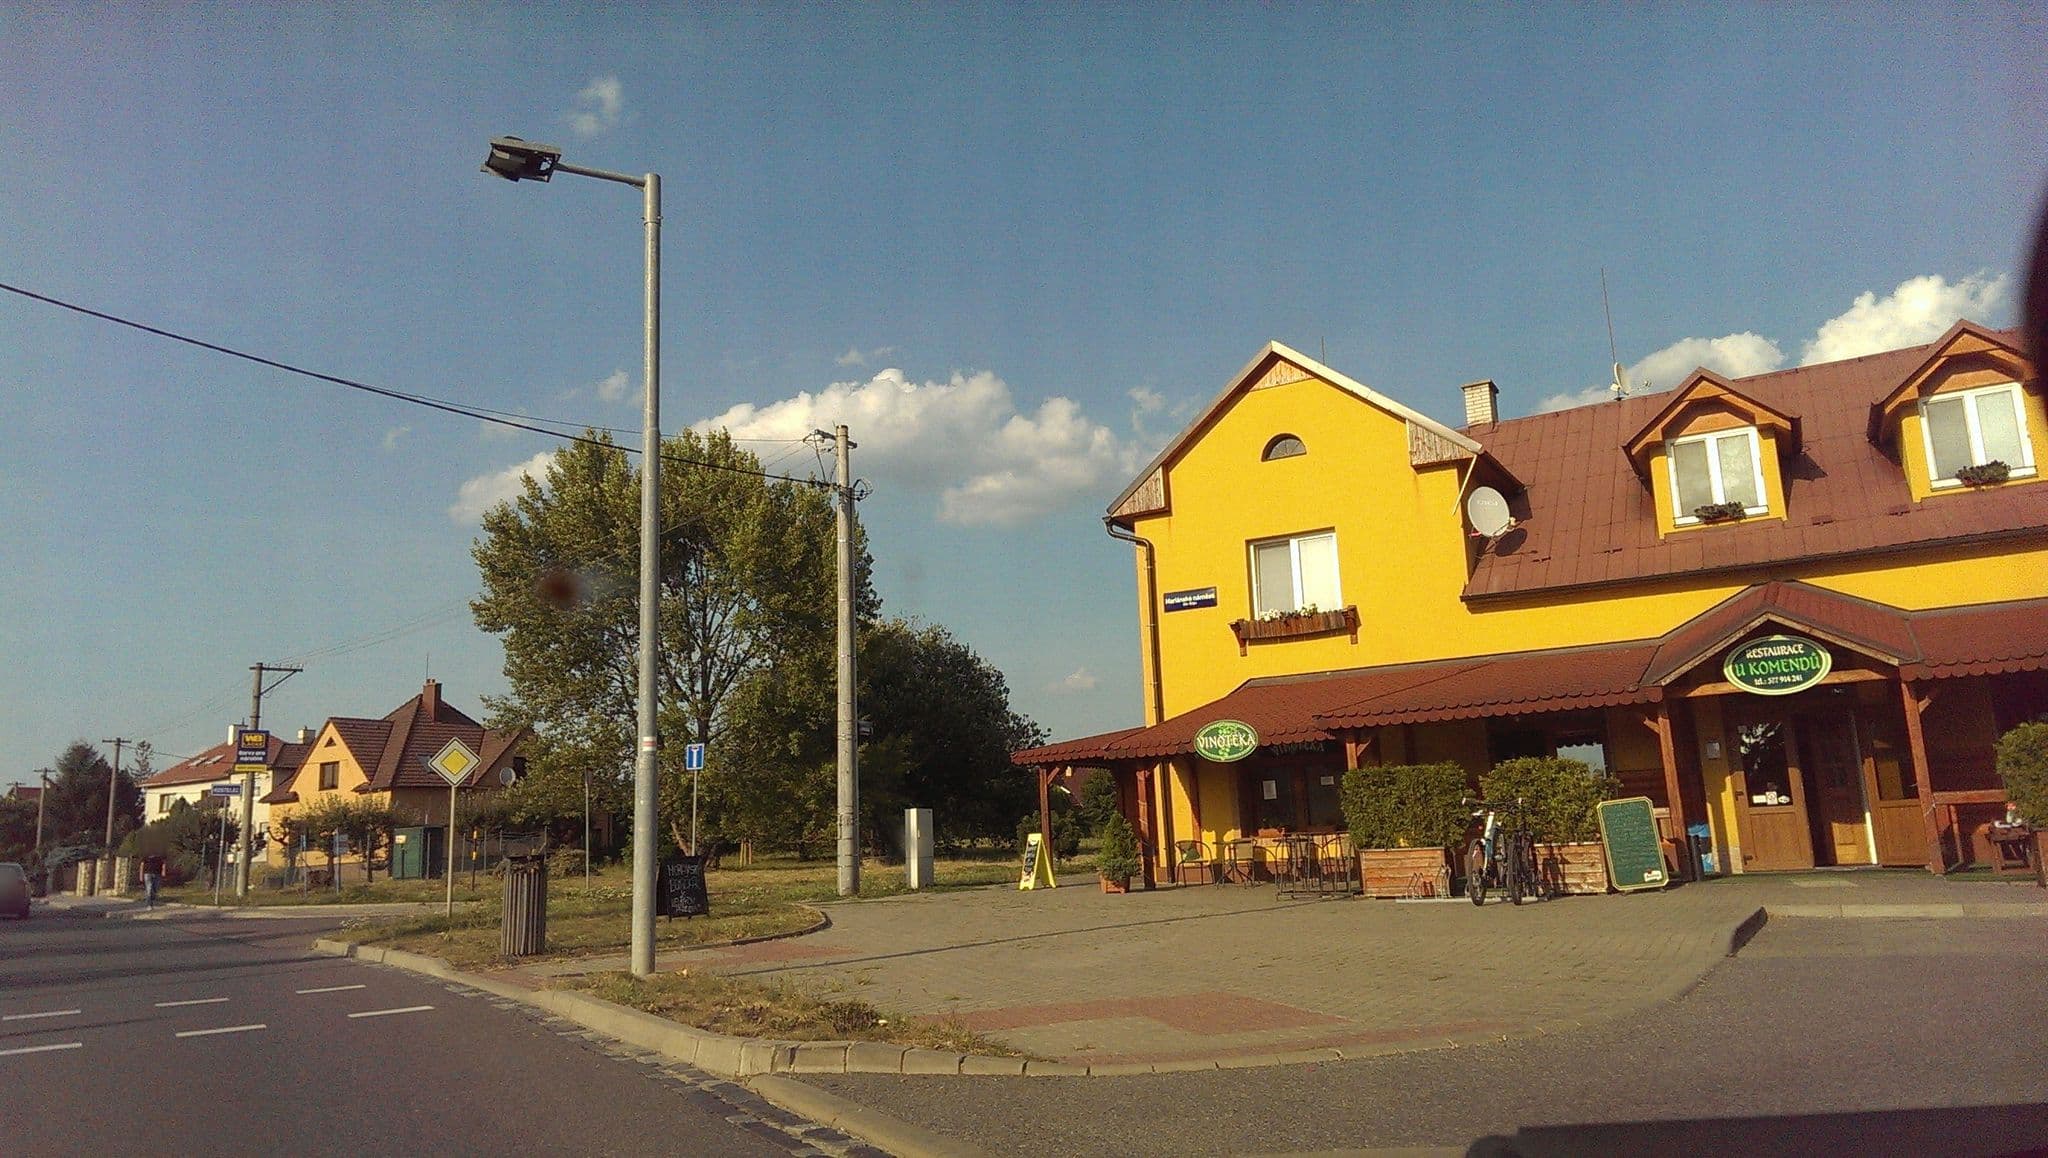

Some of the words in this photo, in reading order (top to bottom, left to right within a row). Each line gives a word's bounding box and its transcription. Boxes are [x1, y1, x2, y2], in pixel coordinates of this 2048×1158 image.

[1746, 643, 1804, 659] RESTAURACE
[1735, 664, 1745, 677] U
[1749, 652, 1821, 676] KOMENDŮ
